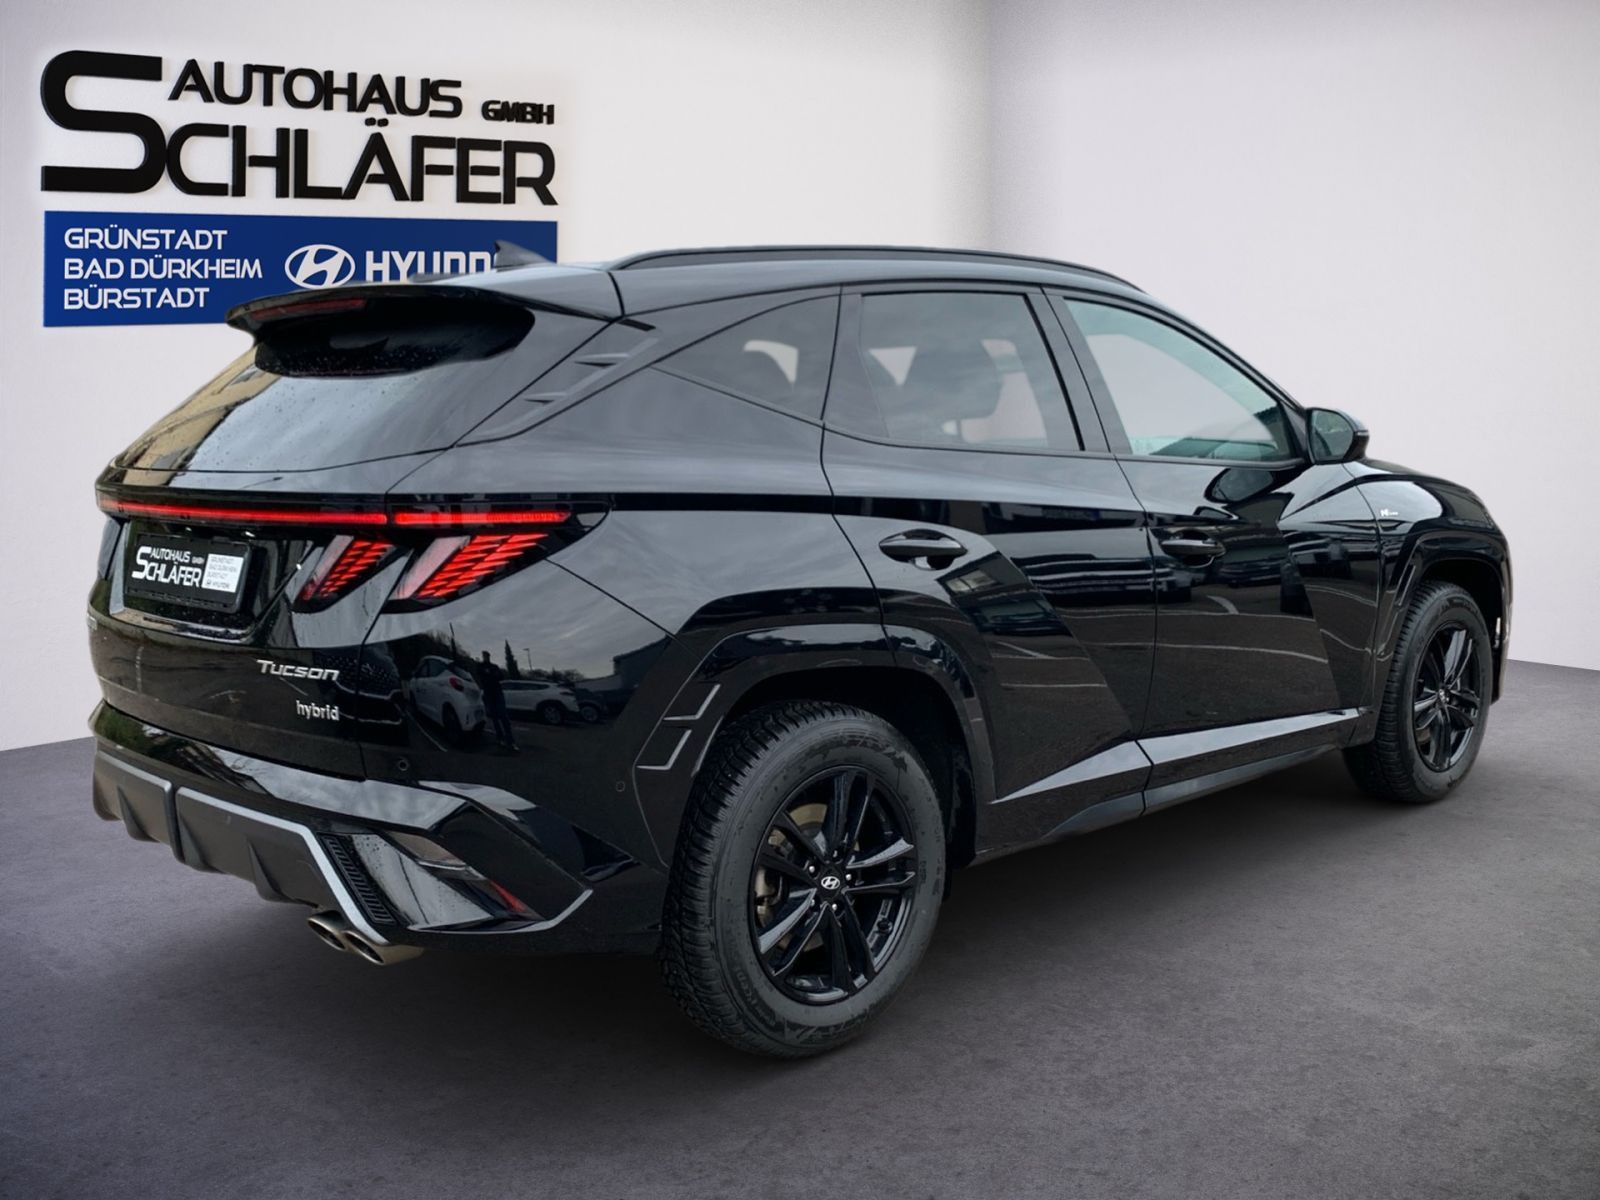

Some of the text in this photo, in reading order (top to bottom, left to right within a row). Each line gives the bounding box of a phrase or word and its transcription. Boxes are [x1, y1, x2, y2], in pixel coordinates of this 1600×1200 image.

[168, 59, 555, 125] AUTOHAUS GMBH
[41, 50, 558, 206] SCHLÄFER
[64, 224, 228, 250] GRÜNSTADT
[64, 254, 263, 280] BAD DÜRKHEIM
[64, 284, 210, 310] BÜRSTADT
[131, 546, 202, 588] SCHLÄFER
[150, 547, 191, 563] AUTOHAUS
[296, 699, 340, 721] hybrid
